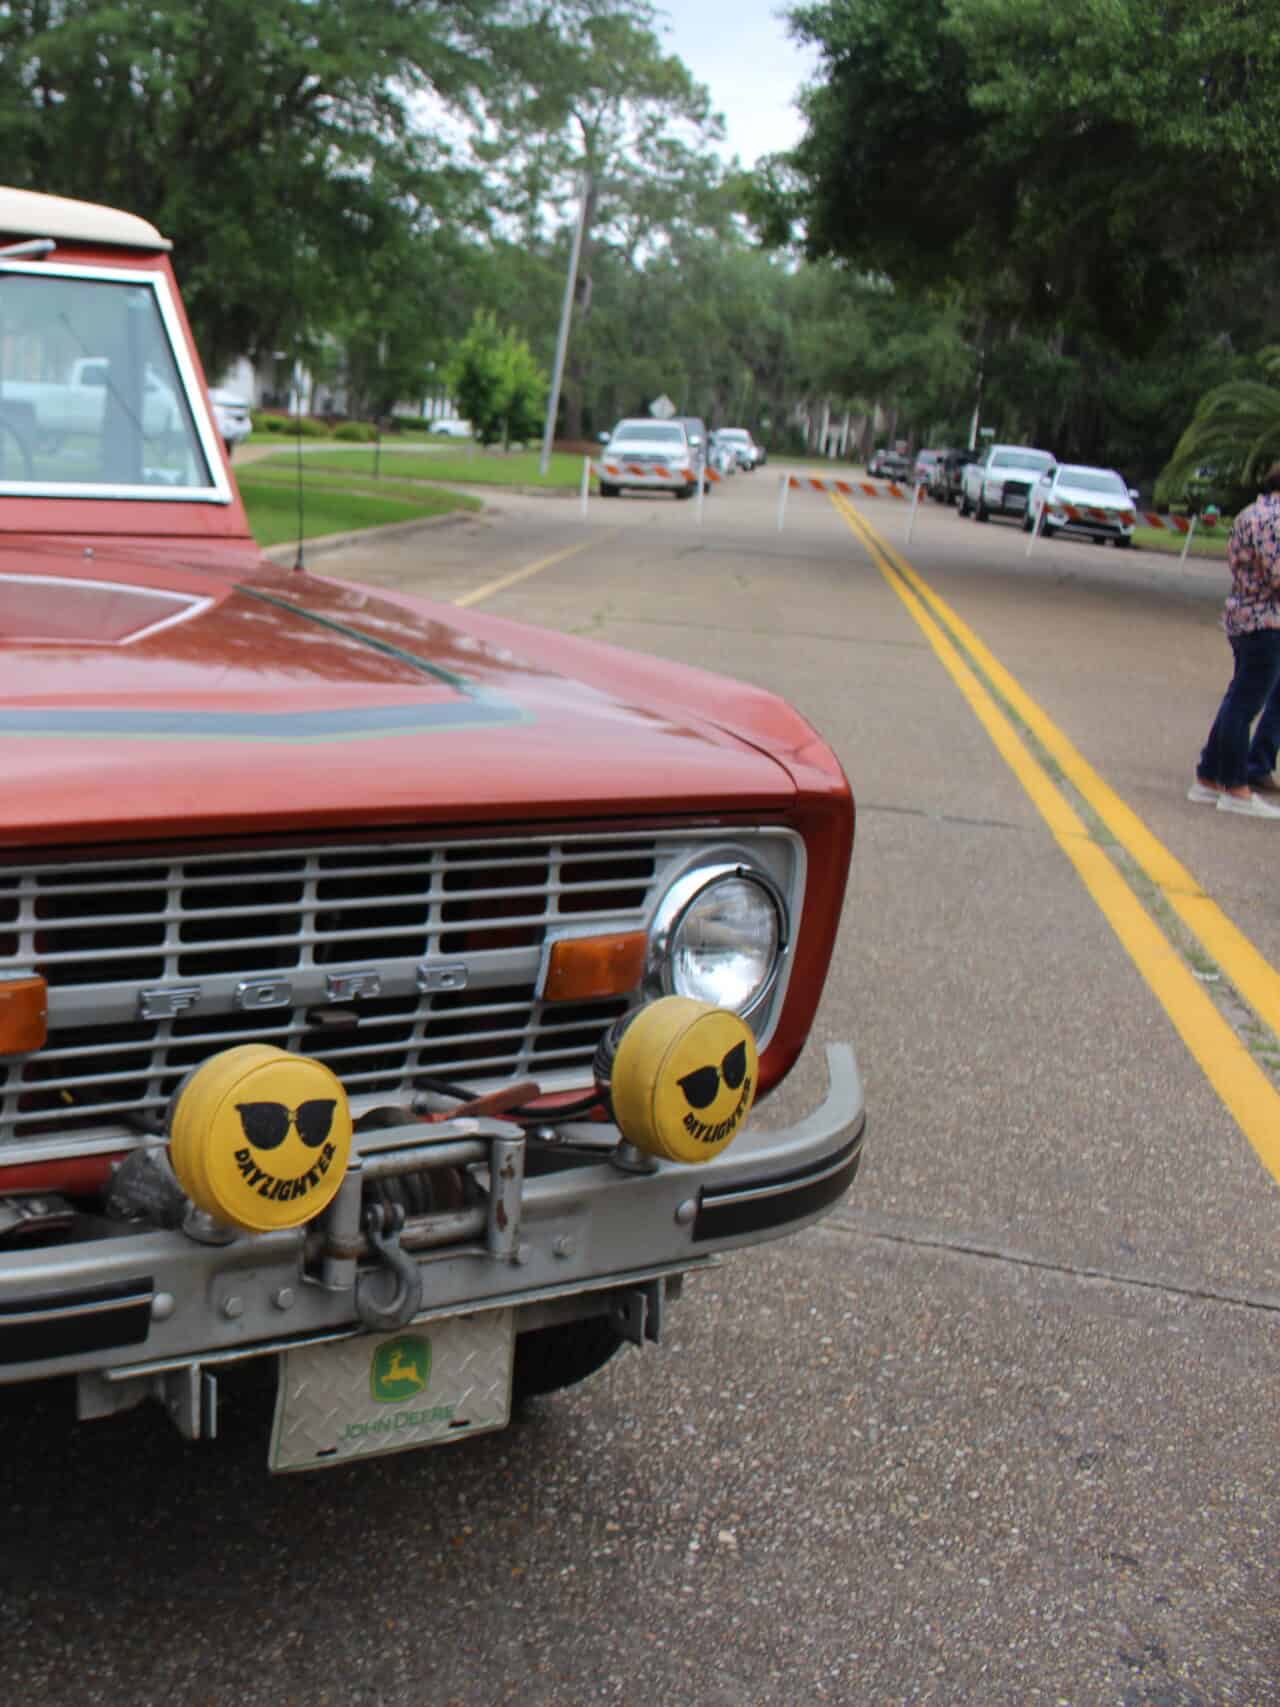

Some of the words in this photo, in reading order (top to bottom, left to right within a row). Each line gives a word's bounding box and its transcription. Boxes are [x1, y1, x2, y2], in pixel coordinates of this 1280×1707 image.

[140, 964, 468, 1020] FORD
[234, 1142, 337, 1202] DAYLIGHTER
[339, 1416, 392, 1440] JOHN
[394, 1405, 455, 1430] DEERE
